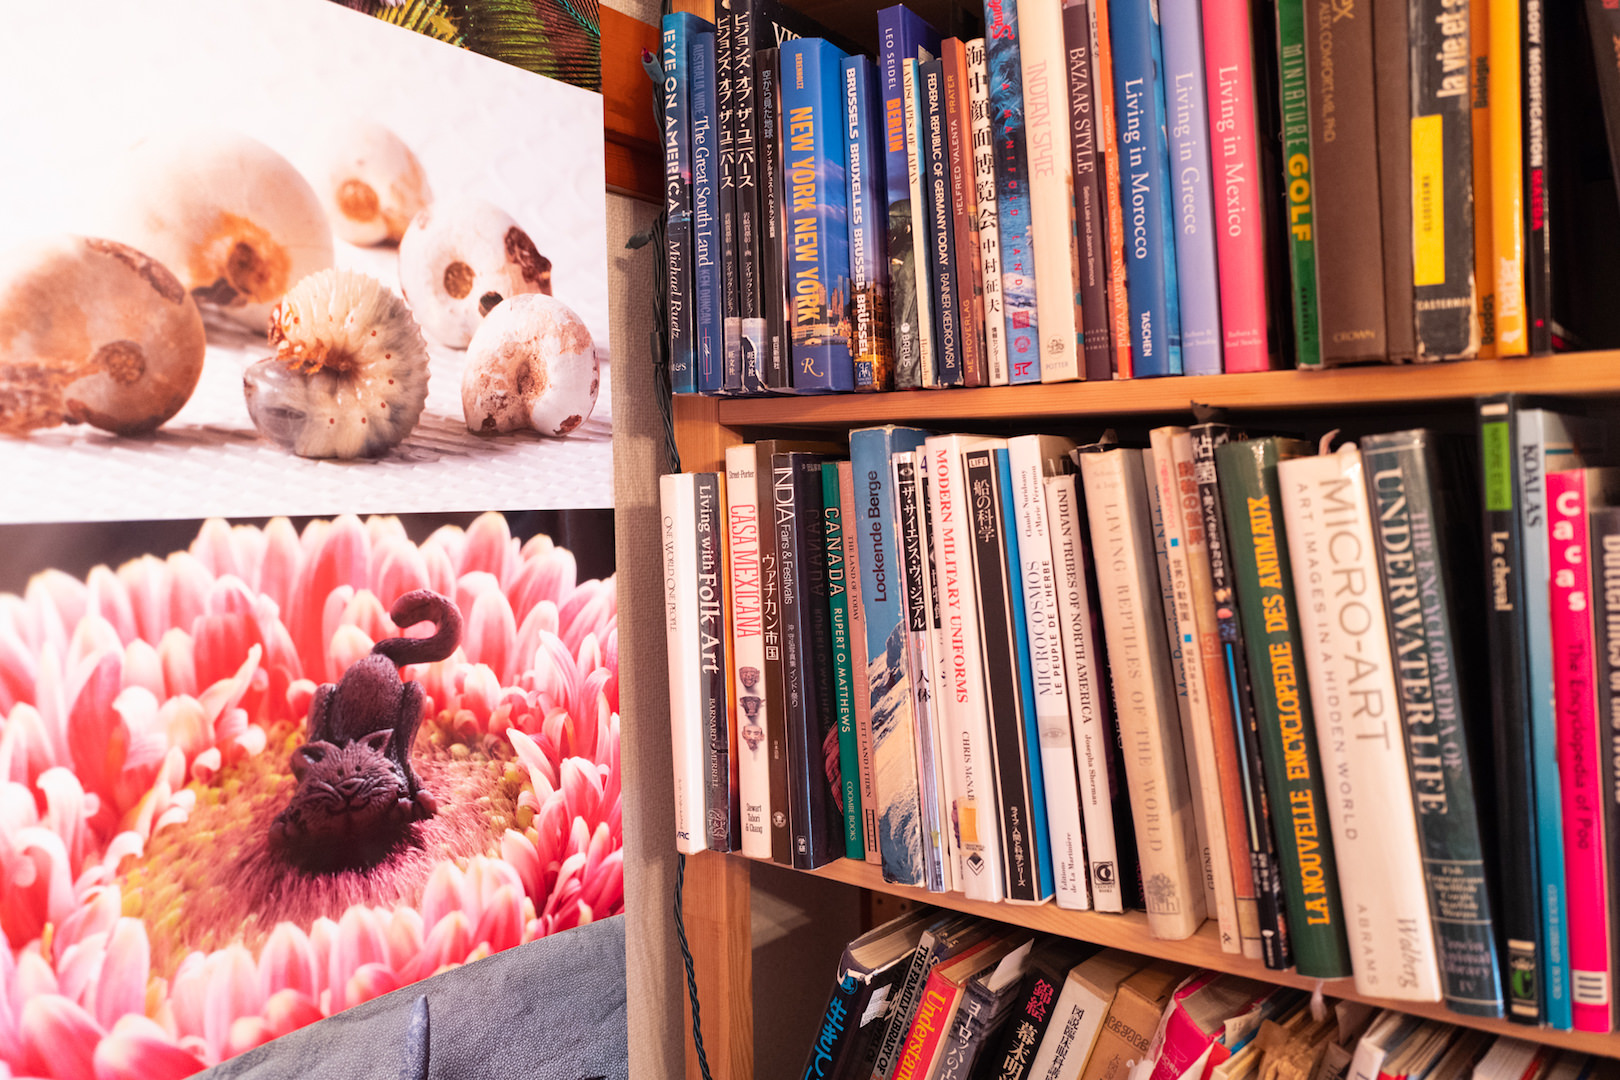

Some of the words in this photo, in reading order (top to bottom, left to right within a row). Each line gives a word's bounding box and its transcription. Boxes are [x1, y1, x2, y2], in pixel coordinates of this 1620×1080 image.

[885, 28, 893, 49] LEO
[1435, 10, 1467, 36] et
[663, 29, 676, 72] EYE
[693, 44, 705, 91] AUSTRALIA
[887, 52, 897, 91] SEIDEL
[1435, 37, 1467, 73] vie
[664, 76, 677, 110] ON
[694, 91, 706, 115] WIDE
[717, 15, 735, 190] ビジョンズ・オブ・ザ・ユニバース
[734, 11, 754, 190] ビジョンズ・オブ・ザ・ユニバース
[846, 67, 859, 139] BRUSSELS
[903, 63, 914, 130] LANDSCAPES
[927, 73, 939, 117] FEDERAL
[948, 74, 958, 114] PRATER
[1027, 60, 1051, 128] INDIAN
[1070, 47, 1090, 116] BAZAAR
[1216, 64, 1239, 133] Living
[1283, 44, 1309, 148] MINIATURE
[1435, 75, 1468, 98] la
[886, 97, 904, 153] BERLIN
[1123, 77, 1145, 143] Living
[1173, 71, 1194, 138] Living
[695, 115, 710, 144] The
[790, 107, 814, 151] NEW
[907, 132, 916, 146] OF
[930, 118, 942, 160] REPUBLIC
[949, 119, 958, 164] VALENTA
[1074, 118, 1094, 175] STYLE
[1180, 140, 1197, 162] in
[1223, 135, 1242, 157] in
[665, 115, 680, 213] AMERICA
[695, 146, 709, 184] Great
[908, 152, 919, 185] JAPAN
[933, 162, 943, 177] OF
[1032, 130, 1054, 179] STYLE
[1129, 146, 1146, 167] in
[792, 156, 816, 213] YORK
[850, 143, 862, 225] BRUXELLES
[952, 166, 963, 215] HELFRIED
[966, 45, 997, 231] 海中顔面博覧会
[983, 238, 1000, 313] 中村征夫
[1181, 166, 1200, 235] Greece
[1225, 162, 1245, 238] Mexico
[1288, 153, 1311, 241] GOLF
[695, 185, 712, 228] South
[934, 179, 947, 231] GERMANY
[1131, 171, 1150, 259] Morocco
[697, 230, 713, 267] Land
[794, 217, 818, 262] NEW
[853, 228, 865, 291] BRUSSEL
[937, 231, 948, 265] TODAY
[669, 240, 682, 297] Michael
[699, 268, 710, 287] KEN
[940, 272, 951, 309] RAINER
[700, 289, 711, 325] DUNCAN
[796, 266, 820, 323] YORK
[671, 299, 682, 341] Ruetz
[856, 295, 870, 357] BRÜSSEL
[942, 310, 955, 369] KEDROWSKI
[962, 299, 972, 374] METROVERLAG
[1141, 310, 1153, 357] TASCHEN
[1334, 330, 1376, 343] CROWN
[1480, 293, 1495, 345] Bordas
[902, 333, 911, 369] BRAUS
[971, 457, 987, 468] LIFE
[774, 468, 796, 524] INDIA
[868, 470, 881, 519] Berge
[936, 449, 953, 523] MODERN
[1297, 482, 1314, 521] ART
[1522, 444, 1542, 529] KOALAS
[664, 516, 672, 539] ONE
[697, 485, 712, 533] Living
[730, 504, 757, 546] CASA
[973, 479, 995, 543] 船の科学
[1057, 489, 1071, 536] INDIAN
[665, 541, 675, 576] WORLD
[702, 535, 715, 570] with
[781, 523, 791, 549] Fairs
[782, 551, 793, 559] &
[825, 507, 845, 597] CANADA
[902, 486, 926, 629] ザ・サイエンス・ヴィジュアル
[1106, 504, 1127, 572] LIVING
[1247, 495, 1282, 589] ANIMAUX
[1491, 531, 1510, 555] Le
[1552, 491, 1587, 612] Cacas
[783, 561, 794, 605] Festivals
[869, 522, 887, 602] Lockende
[942, 528, 960, 610] MILITARY
[1042, 561, 1054, 608] L'HERBE
[1063, 539, 1078, 588] TRIBES
[1305, 531, 1325, 613] IMAGES
[1492, 557, 1513, 611] cheval
[667, 577, 676, 600] ONE
[699, 572, 721, 624] Folk
[733, 548, 761, 638] MEXICANA
[762, 552, 779, 660] ヴァチカン市国
[851, 580, 857, 591] OF
[852, 594, 860, 621] TODAY
[1069, 592, 1080, 610] OF
[668, 602, 677, 632] PEOPLE
[834, 608, 846, 649] RUPERT
[1026, 561, 1053, 696] MICROCOSMOS
[1048, 614, 1056, 628] DE
[1071, 612, 1086, 660] NORTH
[1117, 585, 1142, 679] REPTILES
[1262, 594, 1289, 633] DES
[1317, 622, 1330, 643] IN
[1319, 477, 1390, 750] MICRO-ART
[701, 629, 720, 674] Art
[837, 655, 846, 666] O.
[949, 616, 968, 704] UNIFORMS
[1050, 634, 1061, 680] PEUPLE
[1321, 651, 1332, 663] A
[1373, 467, 1435, 725] UNDERWATER
[1410, 734, 1448, 815] LIFE
[1410, 512, 1433, 554] THE
[1443, 741, 1463, 772] OF
[1568, 644, 1583, 672] The
[838, 668, 850, 733] MATTHEWS
[918, 669, 931, 703] 人体
[1054, 683, 1063, 695] LE
[1077, 662, 1092, 724] AMERICA
[1132, 691, 1147, 716] OF
[709, 697, 717, 742] BARNARD
[1325, 670, 1345, 753] HIDDEN
[962, 731, 972, 764] CHRIS
[1085, 733, 1093, 768] Josepha
[1136, 731, 1152, 768] THE
[1567, 681, 1588, 789] Encyclopedia
[711, 750, 719, 788] MERRELL
[965, 766, 977, 801] McNAB
[1088, 769, 1097, 806] Sherman
[847, 781, 856, 813] COOMBE
[1143, 779, 1163, 851] WORLD
[1337, 761, 1358, 841] WORLD
[1574, 795, 1591, 811] of
[849, 814, 857, 841] BOOKS
[1290, 789, 1326, 894] NOUVELLE
[1577, 817, 1593, 850] Poo
[1305, 897, 1330, 926] LA
[912, 944, 929, 973] THE
[1357, 903, 1378, 985] ABRAMS
[896, 969, 921, 1014] FAMILY
[1025, 978, 1054, 1023] 錦絵
[882, 1011, 905, 1058] LIBRARY
[876, 1056, 889, 1075] OF
